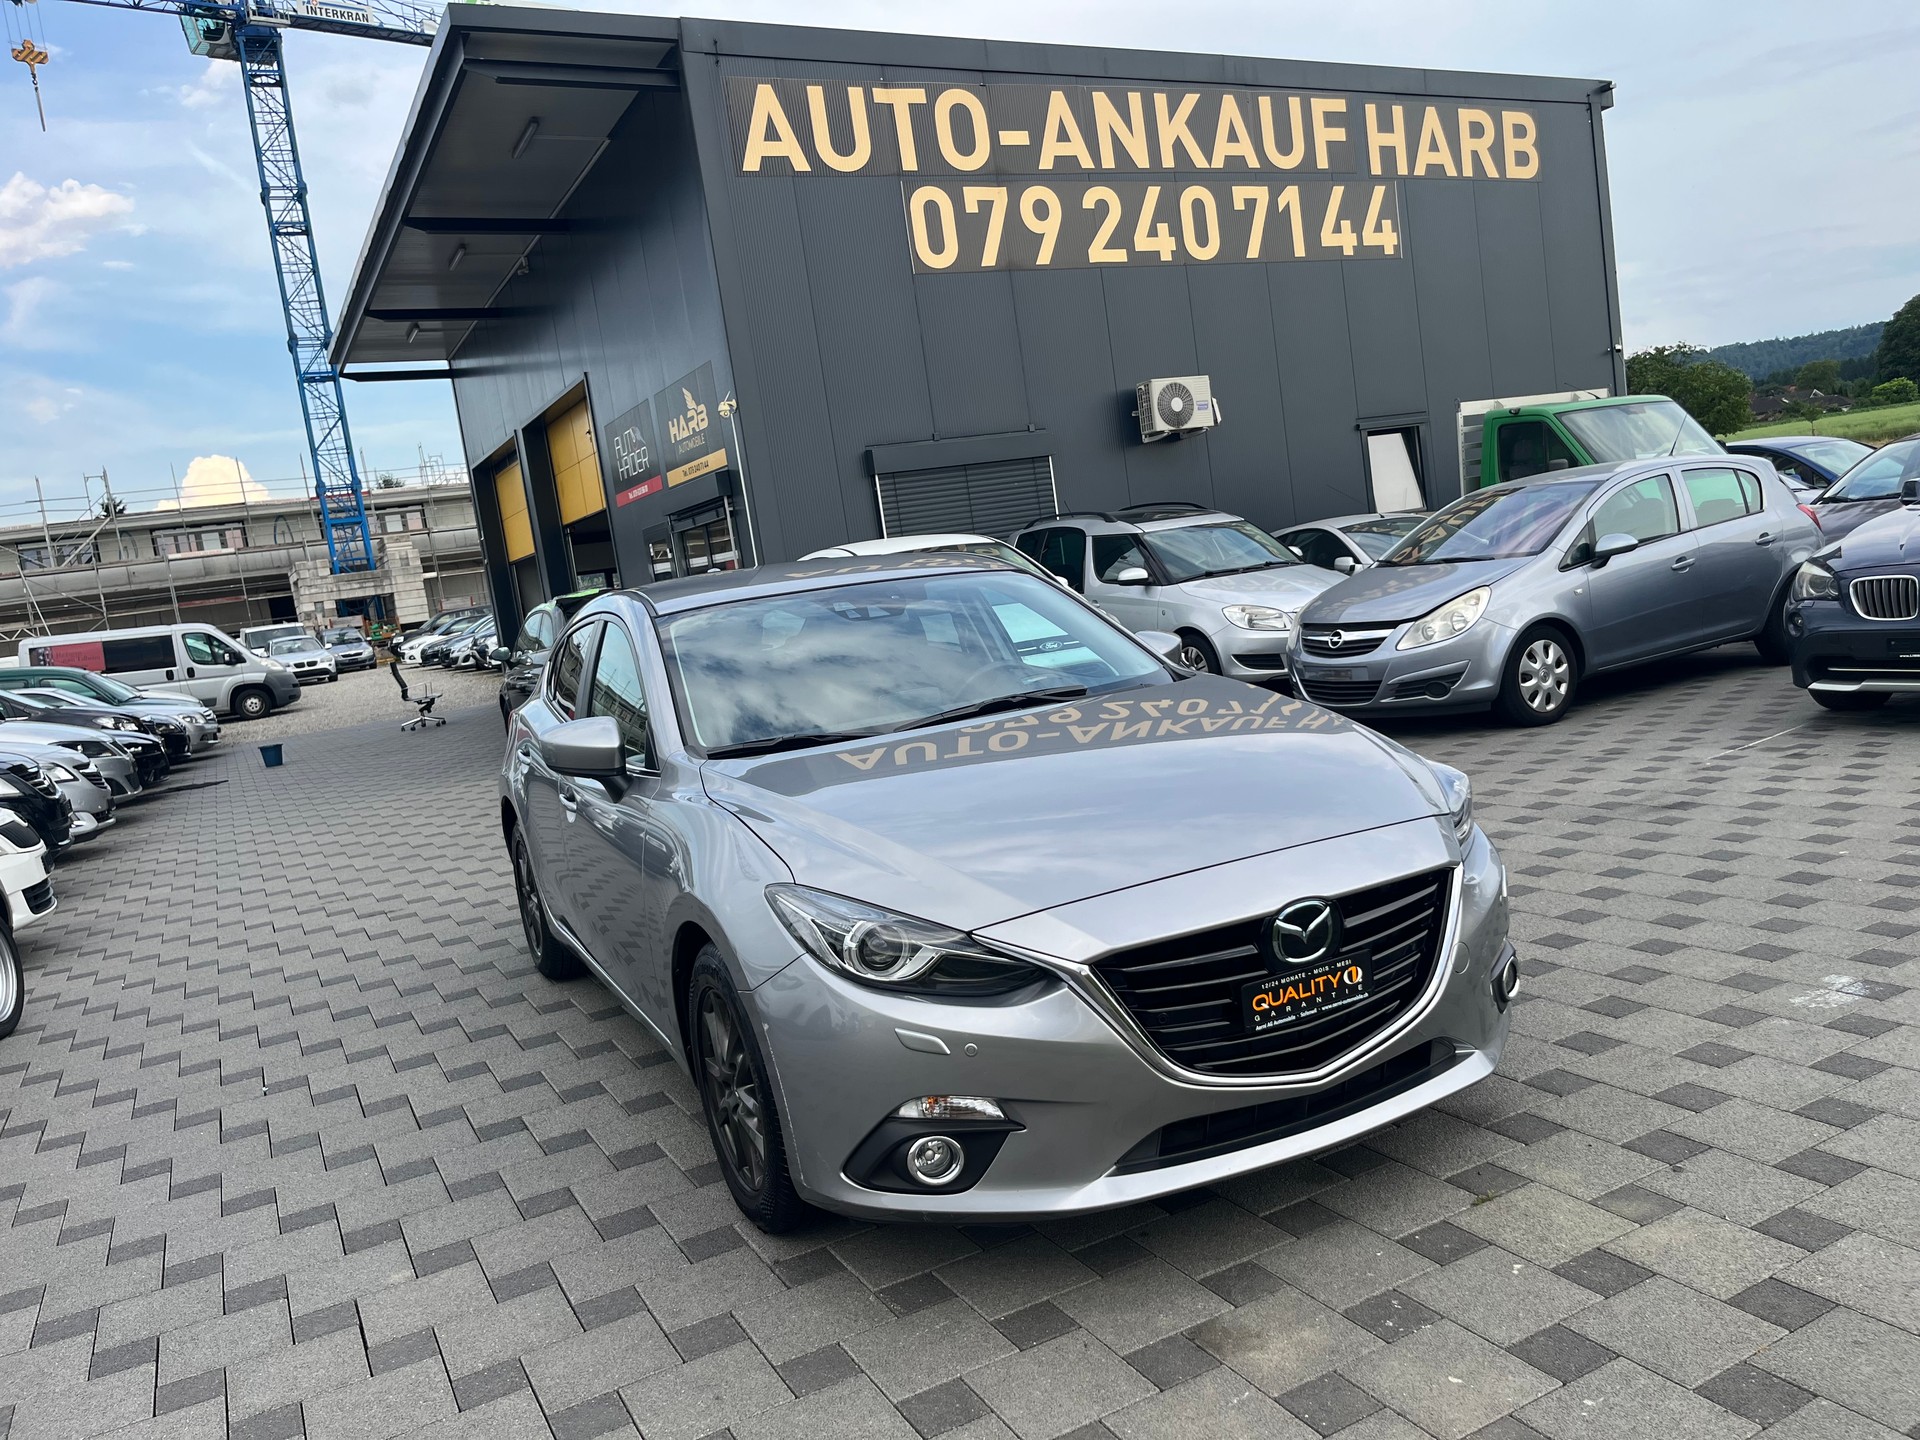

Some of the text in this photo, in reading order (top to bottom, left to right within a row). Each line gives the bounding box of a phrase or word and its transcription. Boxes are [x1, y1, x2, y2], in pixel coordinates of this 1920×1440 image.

[306, 5, 369, 23] INTERKRAN
[743, 84, 1539, 180] AUTO-ANKAUF HARB
[910, 186, 1062, 269] 079
[1082, 185, 1221, 263] 240
[668, 403, 709, 444] HARB
[678, 433, 706, 455] AUTOMOBILE
[1252, 971, 1342, 1011] QUALITY
[1261, 980, 1279, 990] 12/24
[1280, 972, 1306, 984] MONATE
[1313, 965, 1329, 975] MOIS
[1336, 959, 1352, 968] MESI
[1254, 984, 1363, 1022] GARANTIE
